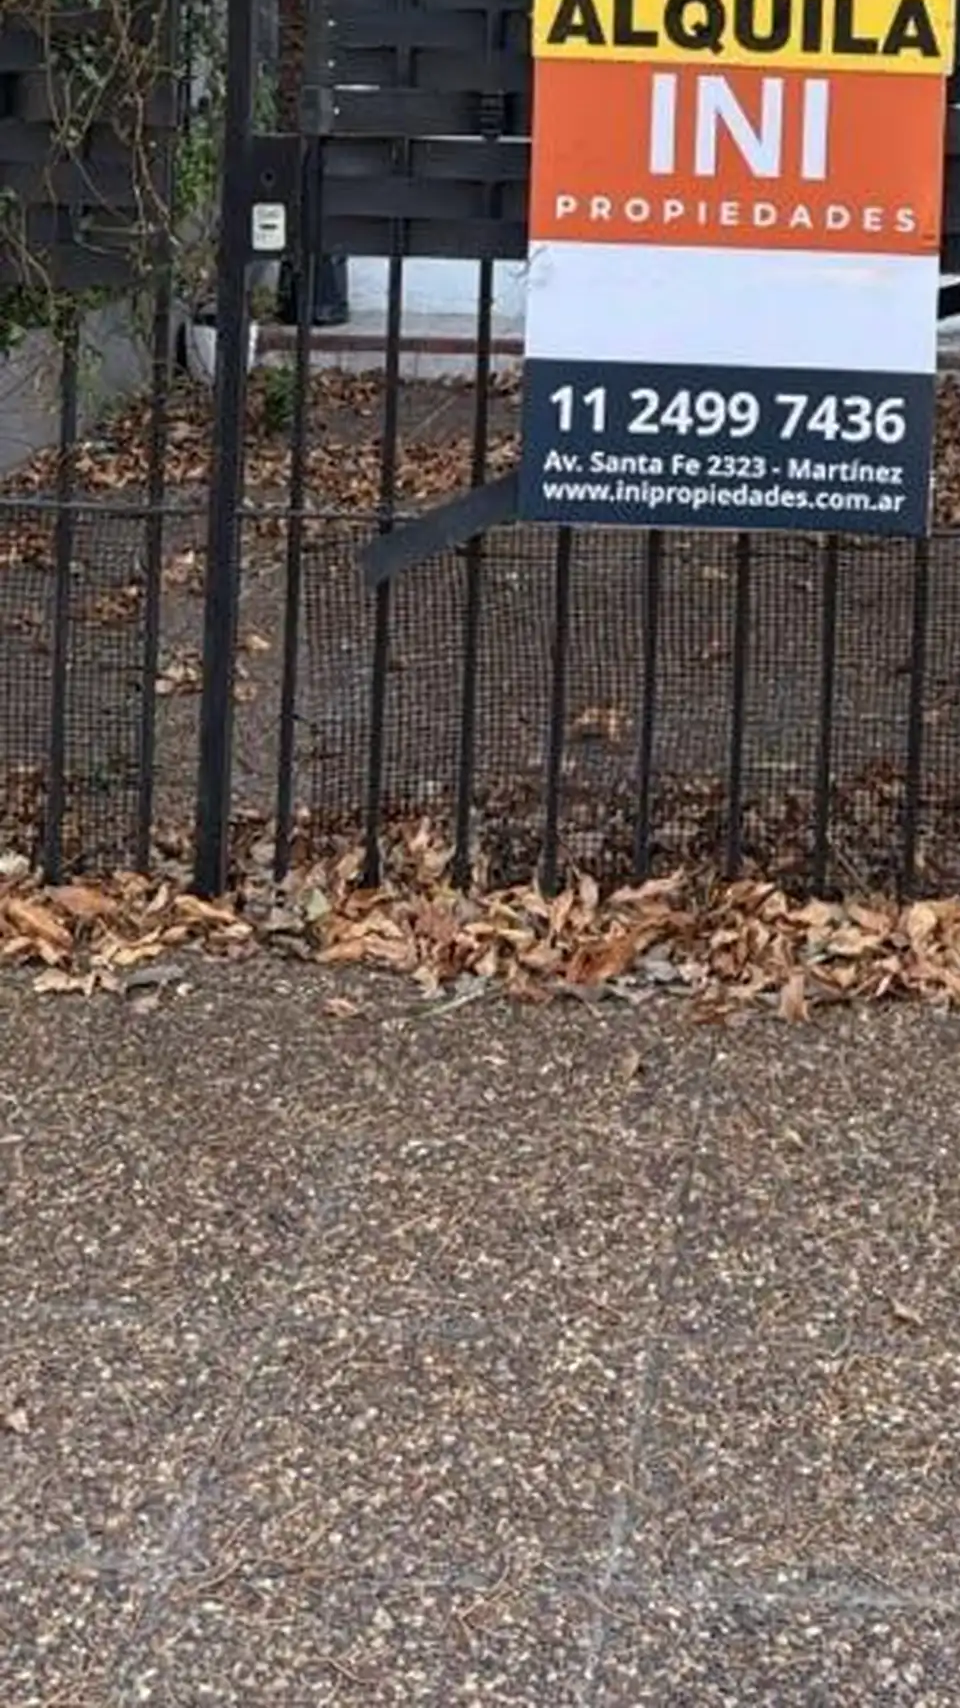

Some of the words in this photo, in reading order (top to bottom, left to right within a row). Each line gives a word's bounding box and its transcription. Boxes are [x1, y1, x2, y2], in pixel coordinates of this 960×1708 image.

[649, 72, 830, 180] INI
[555, 195, 918, 233] PROPIEDADES
[550, 385, 607, 433] 11
[627, 387, 760, 437] 2499
[774, 393, 906, 444] 7436
[543, 449, 583, 474] Av.
[589, 451, 664, 476] Santa
[671, 453, 702, 477] Fe
[706, 453, 767, 480] 2323
[787, 456, 904, 485] Martínez
[541, 479, 908, 513] www.inipropiedades.com.ar
